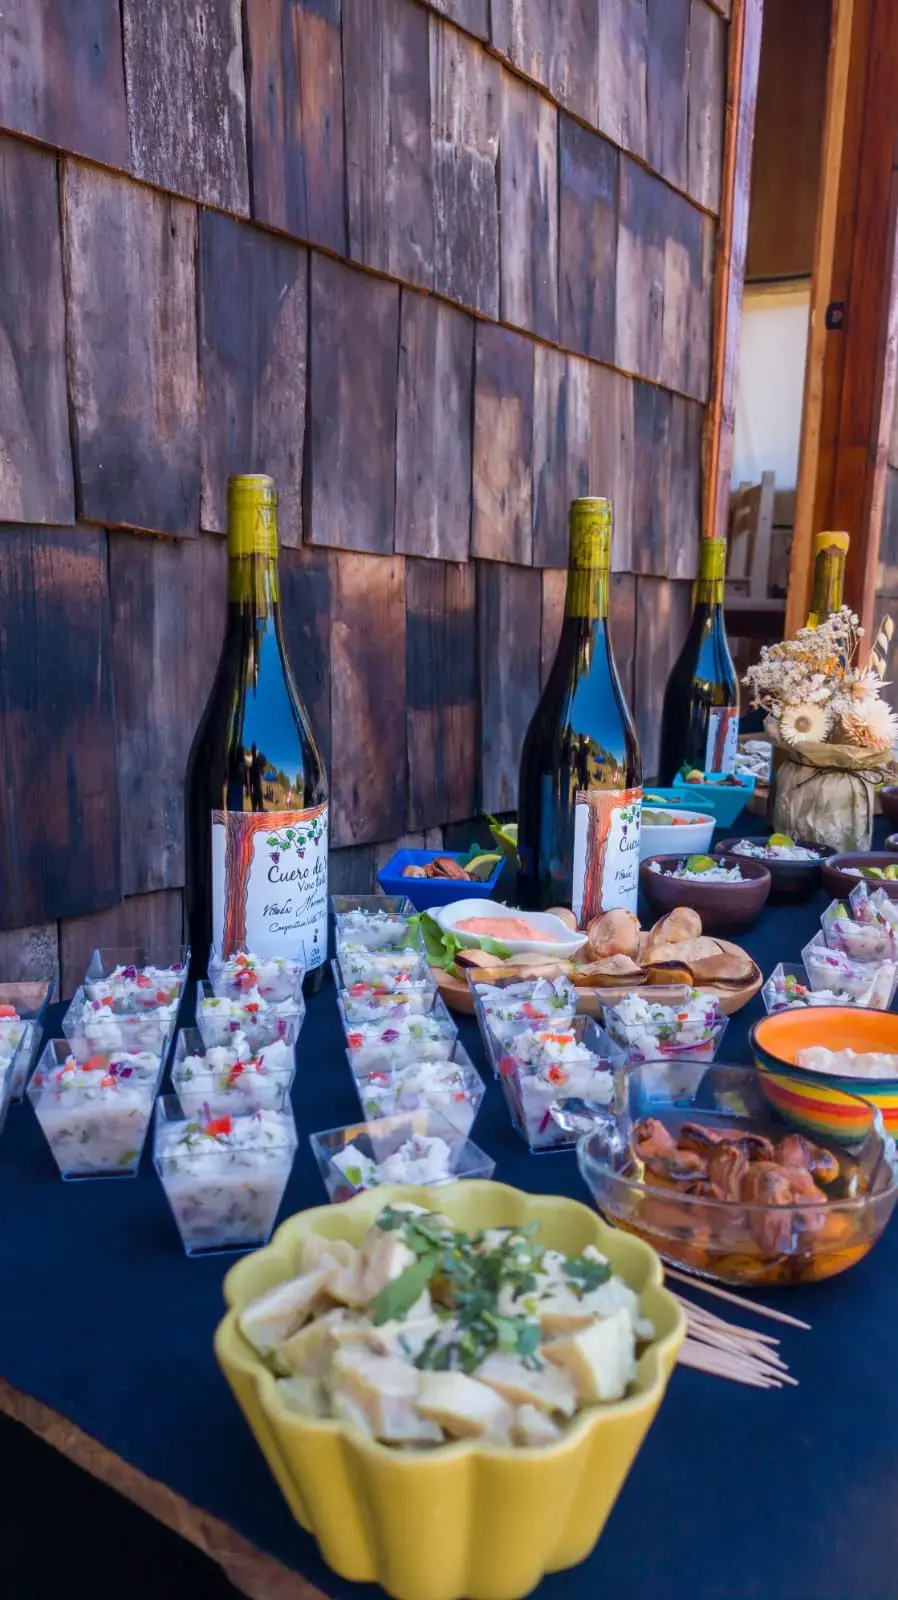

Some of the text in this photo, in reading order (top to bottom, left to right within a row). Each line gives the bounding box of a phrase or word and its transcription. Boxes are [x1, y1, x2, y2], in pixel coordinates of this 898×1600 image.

[268, 865, 309, 883] Cuero
[312, 855, 322, 875] de
[297, 879, 315, 893] Vino
